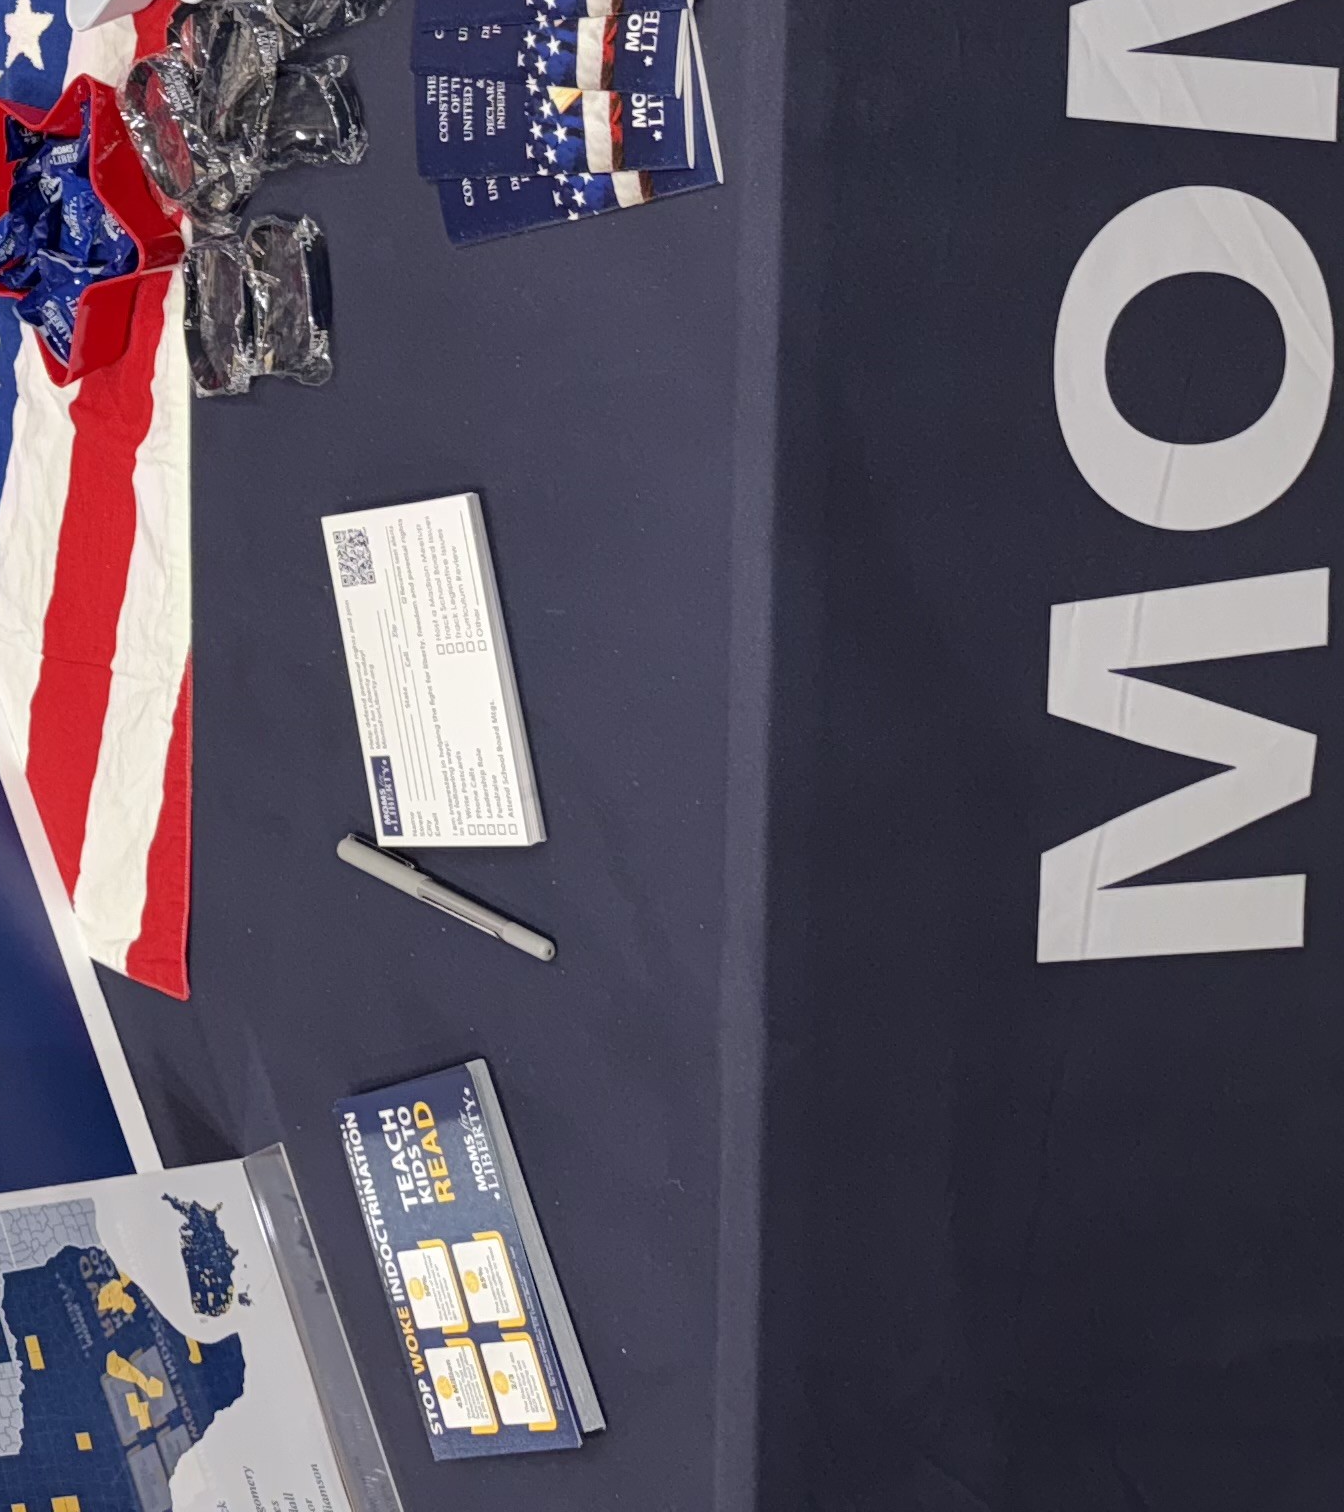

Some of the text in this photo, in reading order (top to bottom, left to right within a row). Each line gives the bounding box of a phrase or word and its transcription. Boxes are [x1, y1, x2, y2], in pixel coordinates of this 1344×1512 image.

[492, 725, 504, 752] Board
[497, 753, 509, 785] School
[379, 788, 391, 825] MOMS
[478, 770, 494, 819] Leadership
[378, 1108, 419, 1212] TEACH
[397, 1105, 434, 1204] KIDS TO
[412, 1101, 456, 1203] READ
[462, 1095, 501, 1190] LIBERTY
[464, 1135, 488, 1192] MOMS
[342, 1112, 444, 1435] STOP WOKE INDOCTRINATION
